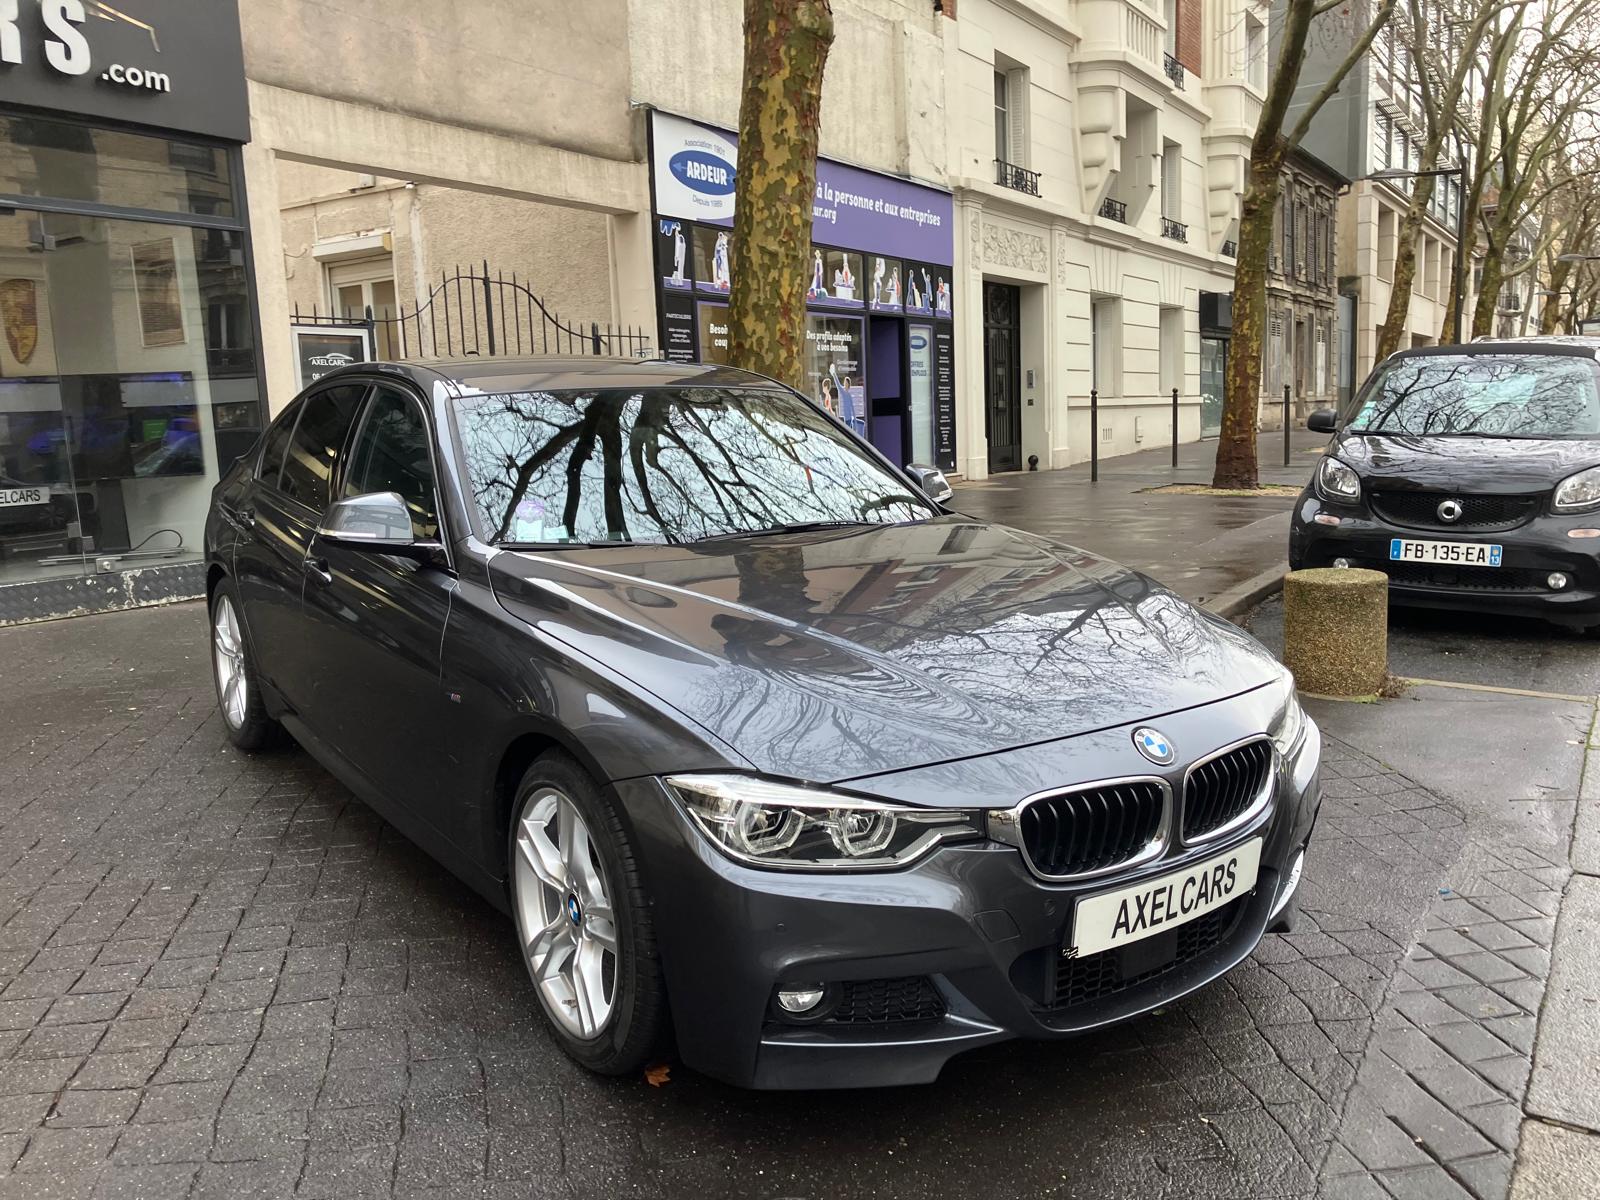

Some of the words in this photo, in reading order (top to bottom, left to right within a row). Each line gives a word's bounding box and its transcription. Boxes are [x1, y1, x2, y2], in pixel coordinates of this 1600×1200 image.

[102, 63, 171, 92] .com
[686, 160, 728, 186] ARDEUR
[816, 182, 823, 199] à
[824, 183, 834, 201] la
[834, 190, 874, 211] personne
[874, 199, 884, 213] et
[884, 203, 899, 217] aux
[899, 206, 941, 227] entreprises
[806, 329, 816, 340] Des
[816, 331, 833, 343] profils
[1404, 543, 1486, 563] FB-135-EA
[1491, 555, 1499, 564] 13
[1111, 857, 1238, 940] AXELCARS
